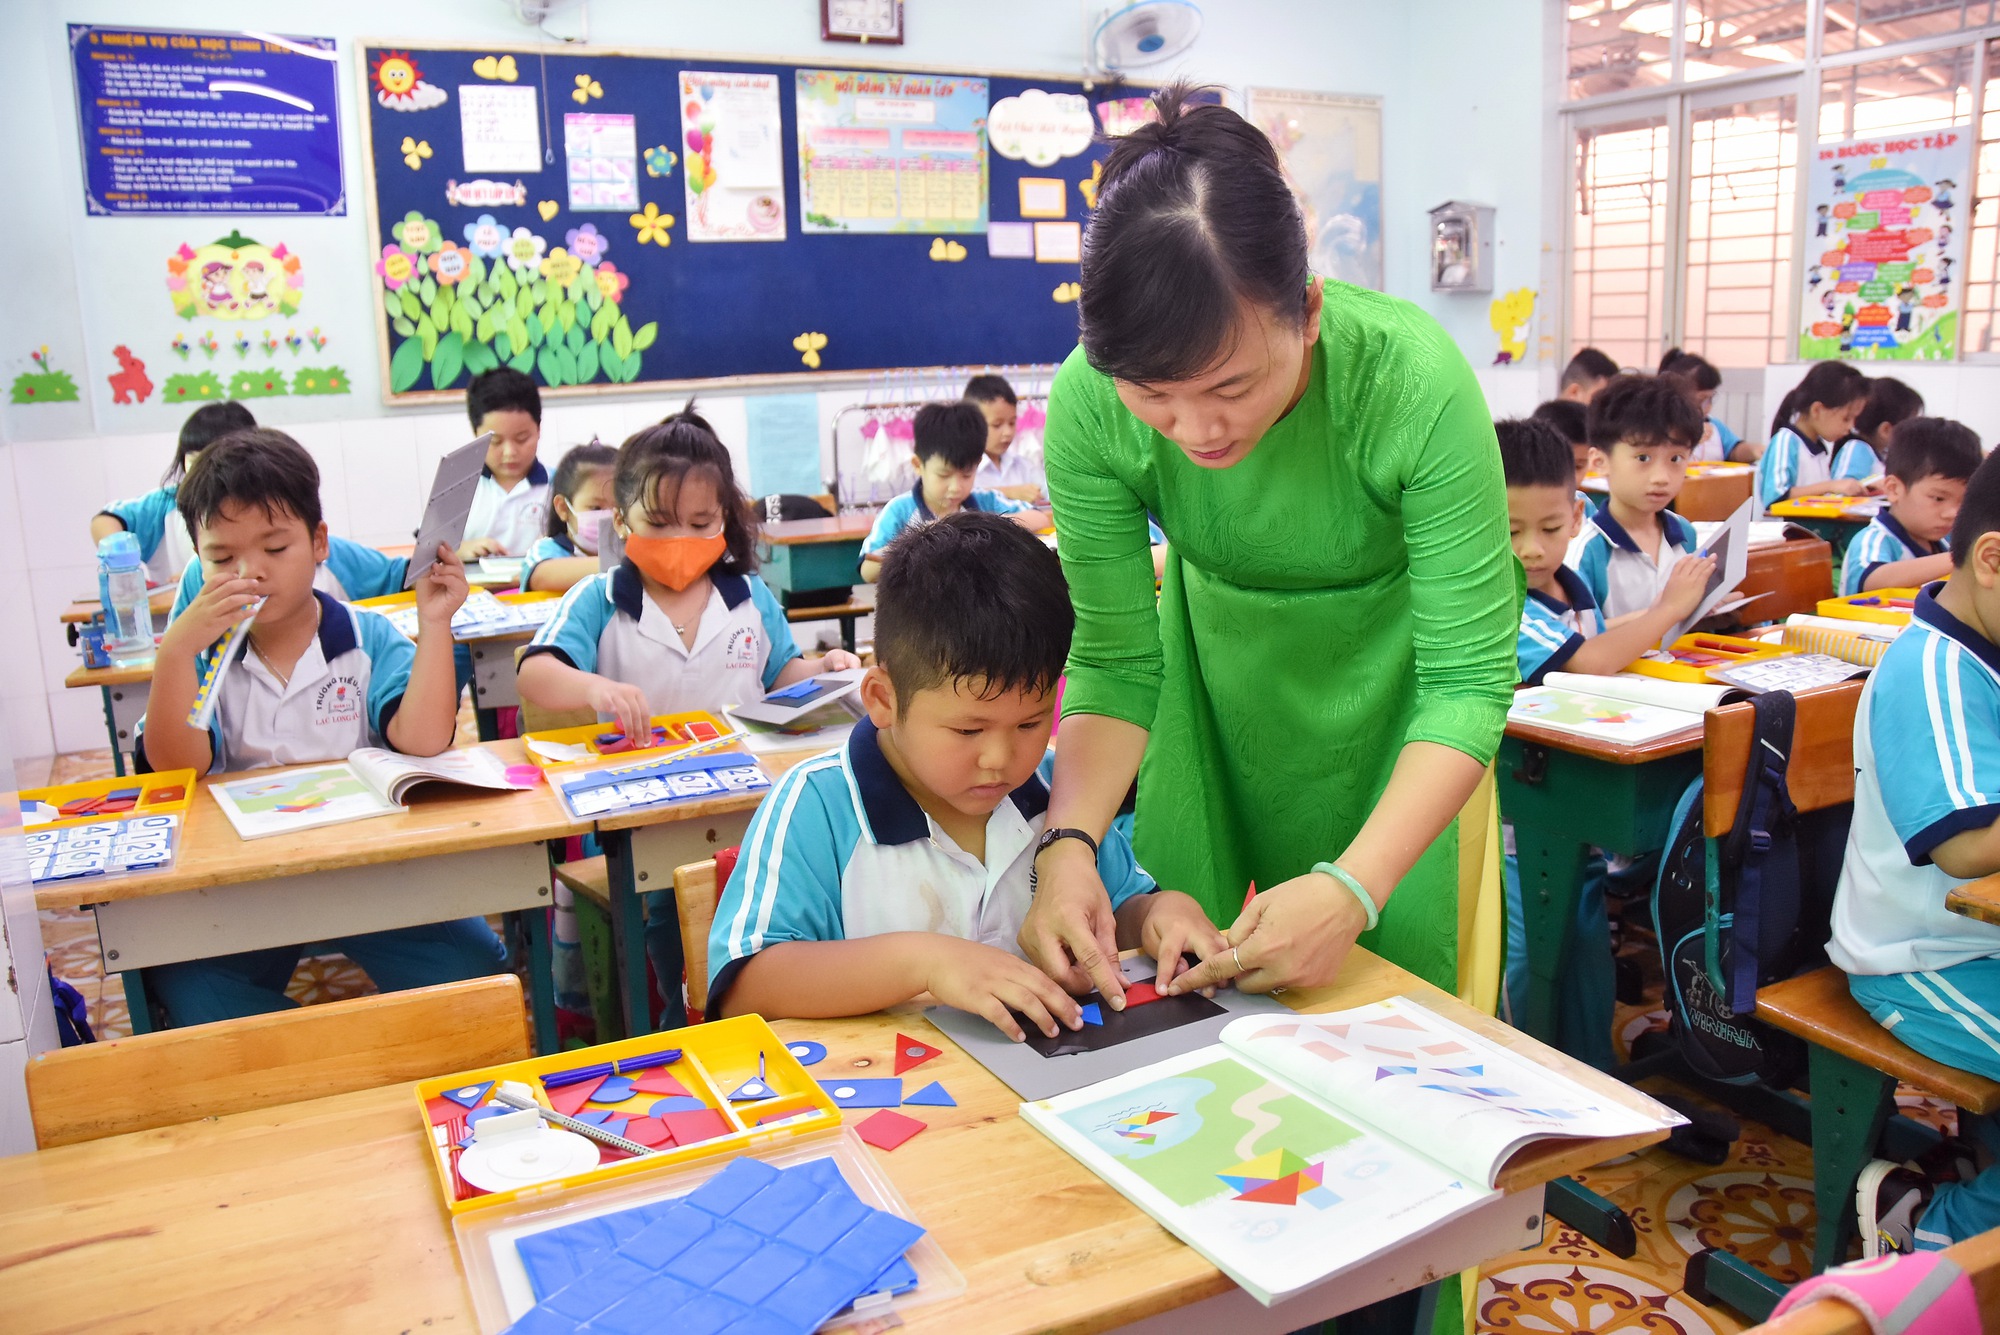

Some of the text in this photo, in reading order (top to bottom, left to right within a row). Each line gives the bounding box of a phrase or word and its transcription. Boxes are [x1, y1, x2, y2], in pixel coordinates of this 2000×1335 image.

[733, 776, 758, 784] 3
[686, 782, 712, 790] 7
[142, 816, 171, 828] 0
[66, 826, 111, 868] 4 5 6 7
[127, 842, 157, 851] 2
[134, 852, 164, 861] 3
